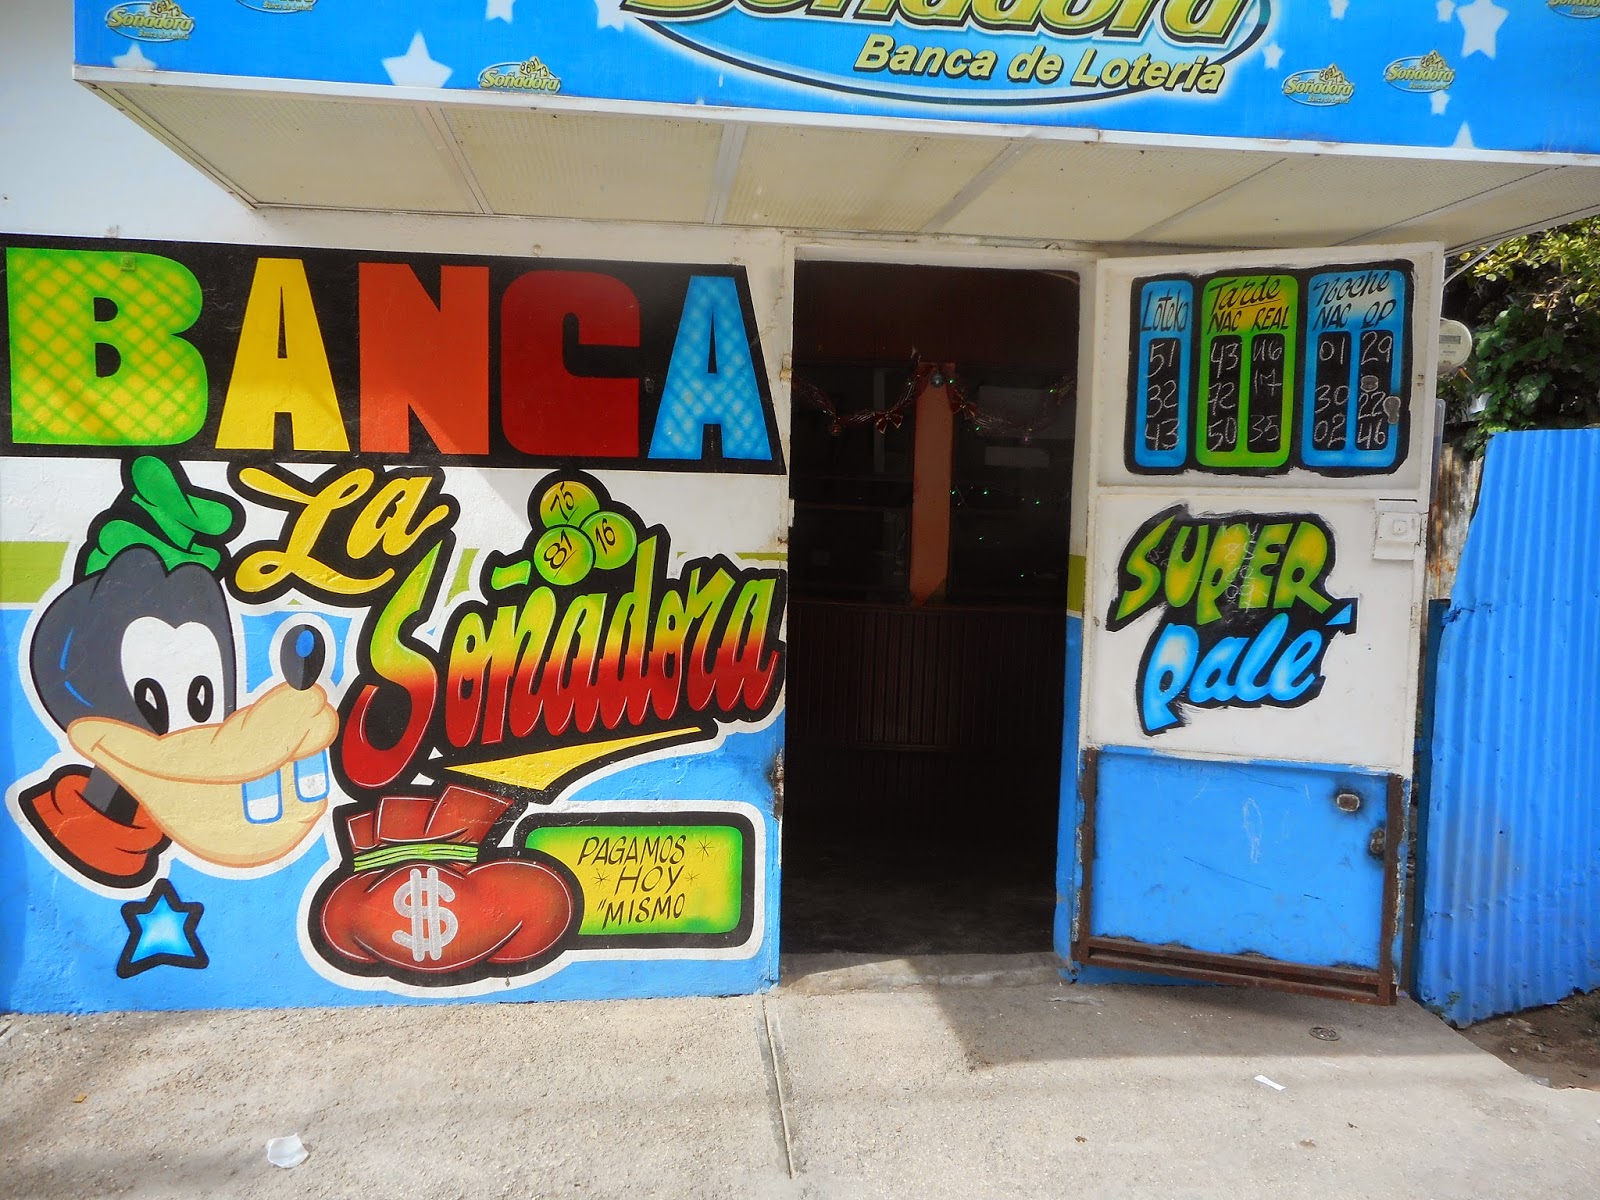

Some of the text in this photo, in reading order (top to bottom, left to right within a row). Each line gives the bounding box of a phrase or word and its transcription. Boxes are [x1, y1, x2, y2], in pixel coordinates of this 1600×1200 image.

[107, 7, 193, 31] Soñadora
[480, 69, 560, 91] Soñadora
[853, 33, 1225, 94] Banca de Loteria
[1385, 64, 1454, 83] Soñadora
[1284, 76, 1353, 96] Soñadora
[1208, 275, 1280, 316] Tarde
[1313, 271, 1390, 307] Noche
[1207, 305, 1289, 335] NAC REAL
[1312, 303, 1351, 331] NAC
[5, 247, 773, 461] BANCA
[1147, 340, 1176, 378] 51
[1210, 342, 1239, 378] 43
[1320, 331, 1393, 365] 01 29
[1147, 380, 1178, 418] 32
[1208, 382, 1236, 416] 72
[1314, 384, 1386, 420] 30 22
[1145, 418, 1179, 450] 43
[1208, 414, 1279, 452] 50 35
[1314, 412, 1386, 449] 02 46
[236, 466, 450, 594] La
[596, 518, 616, 555] 16
[1115, 514, 1333, 626] SUPER
[342, 535, 780, 789] Soñadora
[577, 834, 687, 866] PAGAMOS
[614, 864, 685, 895] HOY
